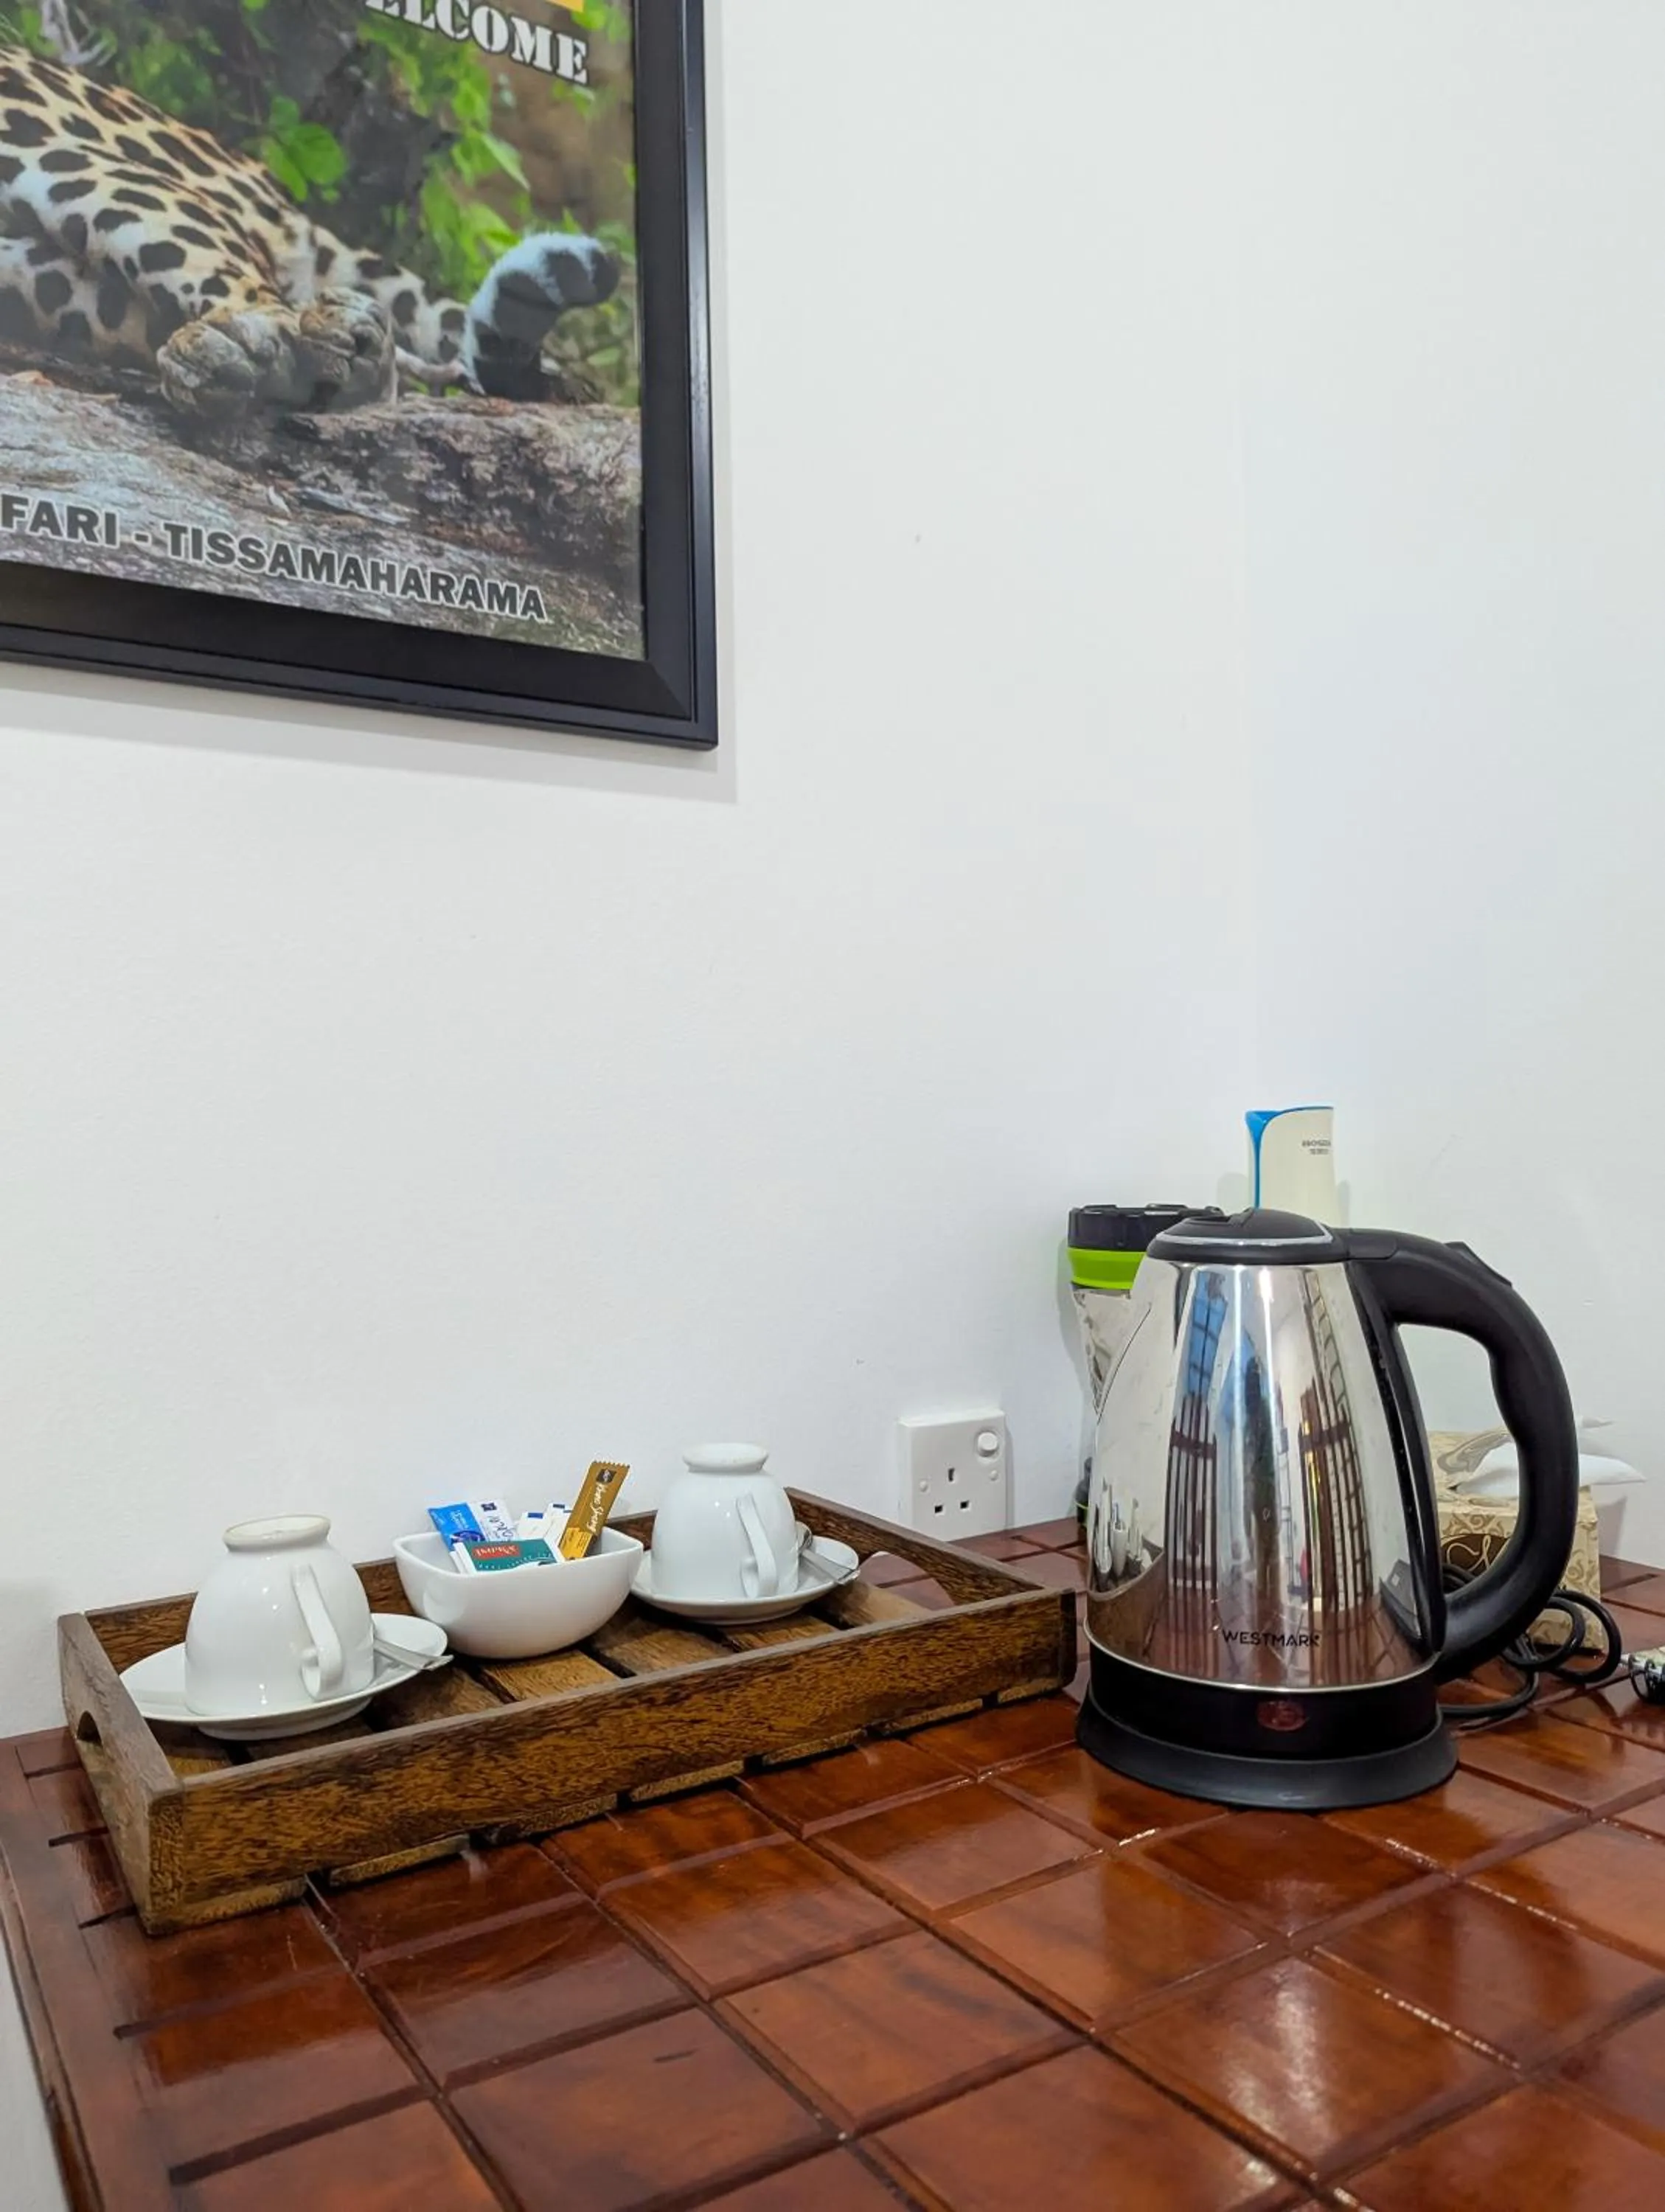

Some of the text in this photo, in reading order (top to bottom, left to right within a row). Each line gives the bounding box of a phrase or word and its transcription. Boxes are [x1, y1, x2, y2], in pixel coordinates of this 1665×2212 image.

[1, 493, 118, 547] FARI
[162, 522, 547, 621] TISSAMAHARAMA
[1221, 1630, 1321, 1646] WESTMARK
